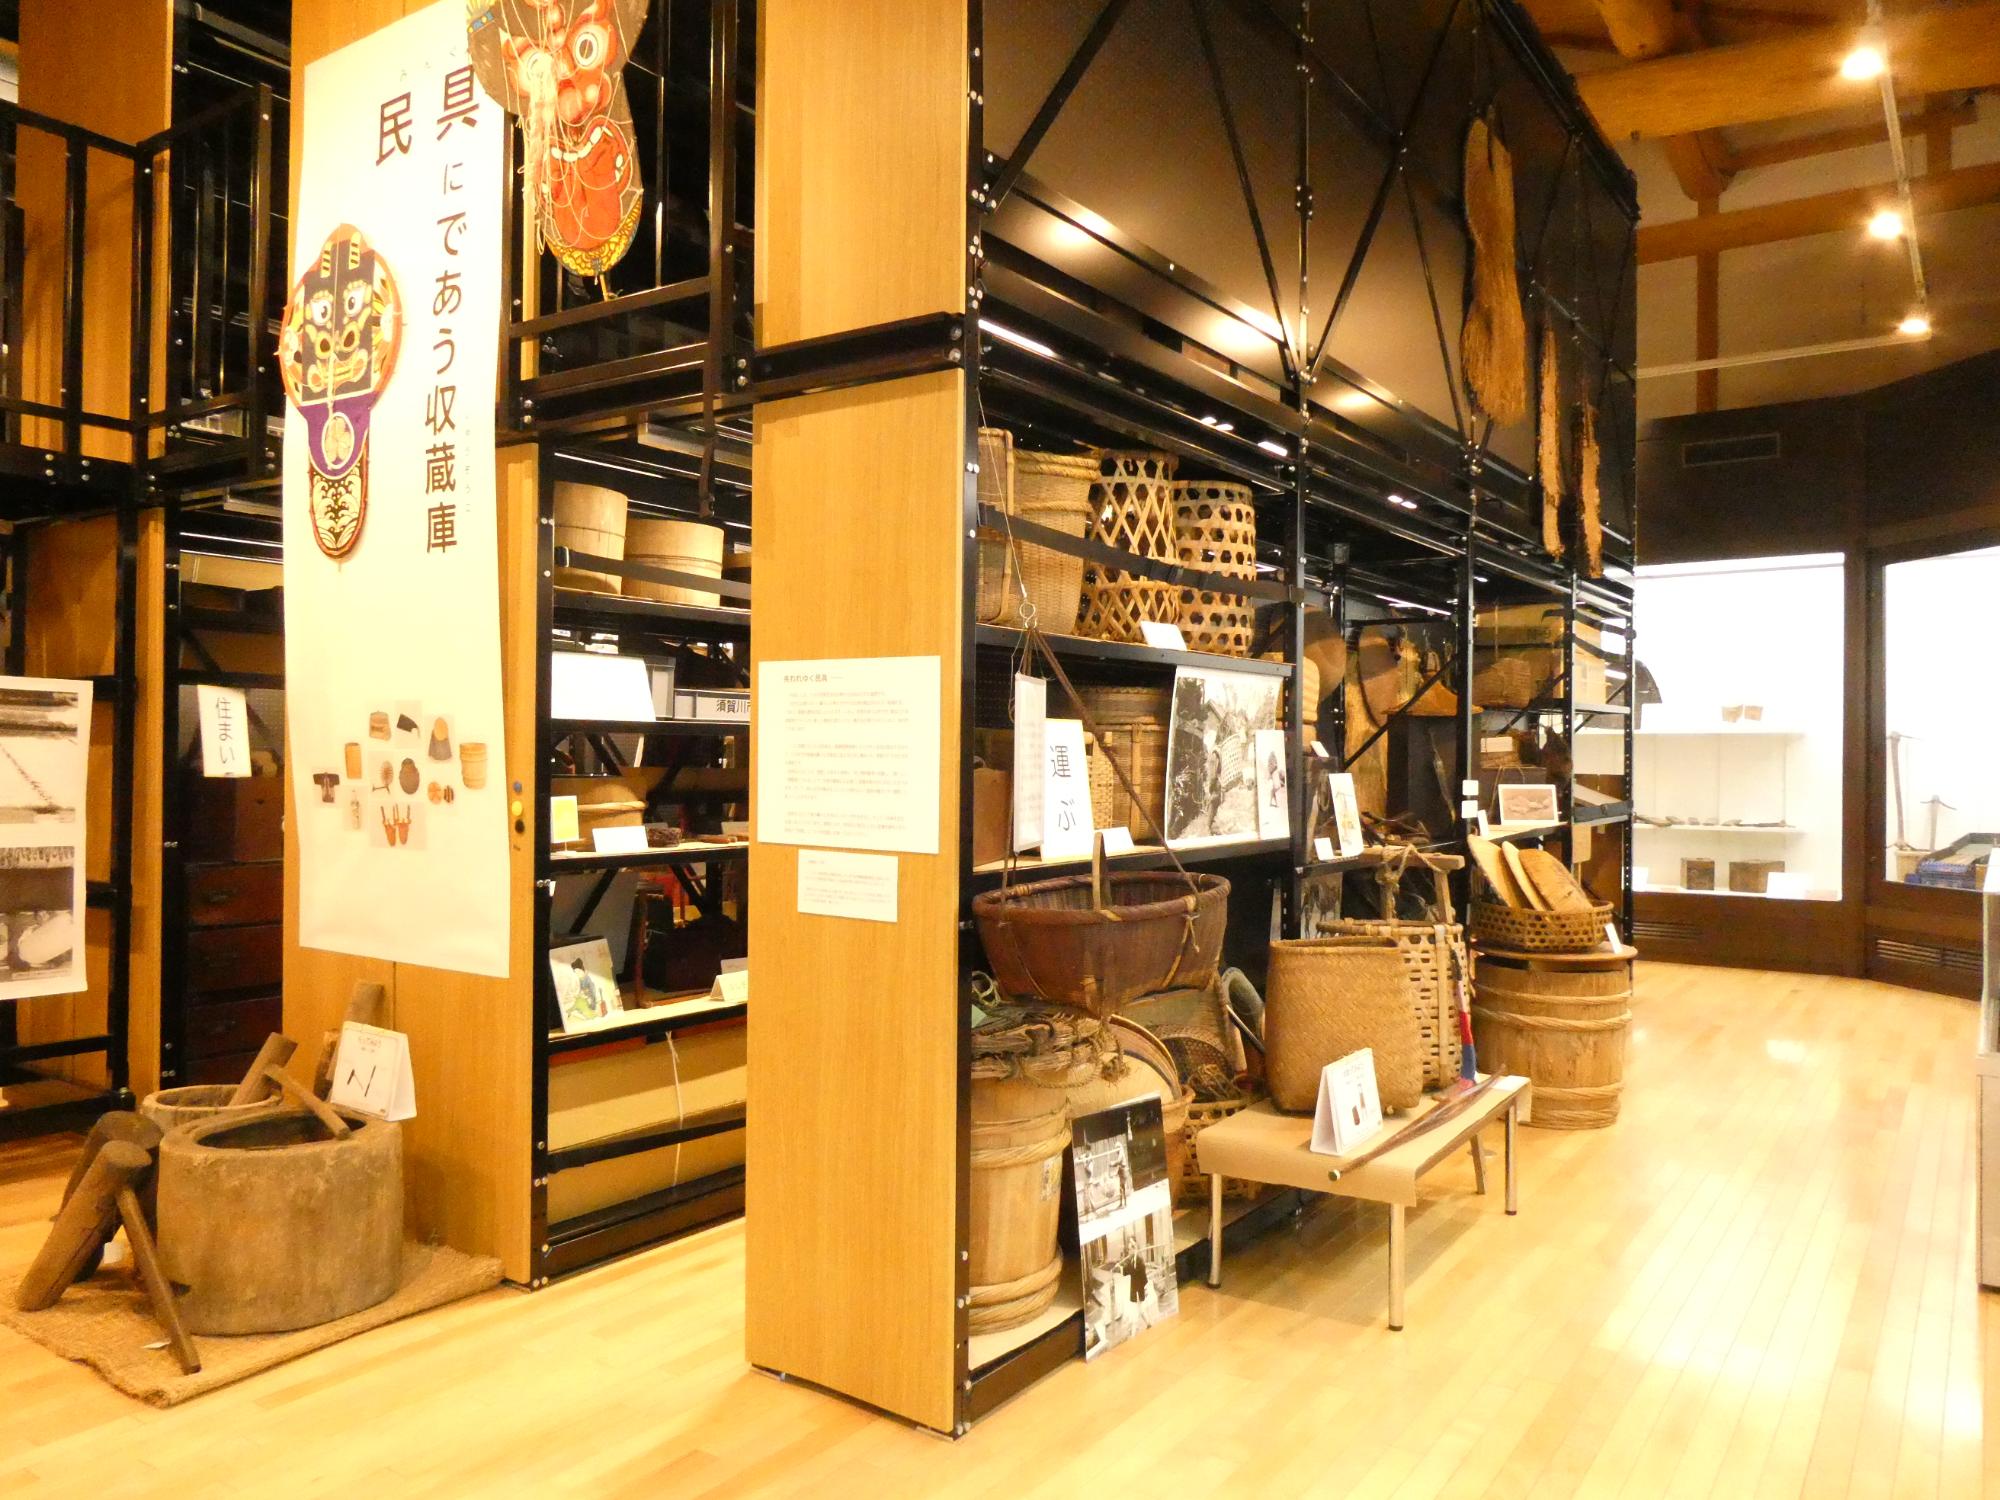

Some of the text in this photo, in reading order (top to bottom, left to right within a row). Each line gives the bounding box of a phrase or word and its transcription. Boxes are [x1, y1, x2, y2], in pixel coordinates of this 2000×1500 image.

[216, 697, 235, 764] 住まい
[1050, 745, 1077, 831] 運ぶ
